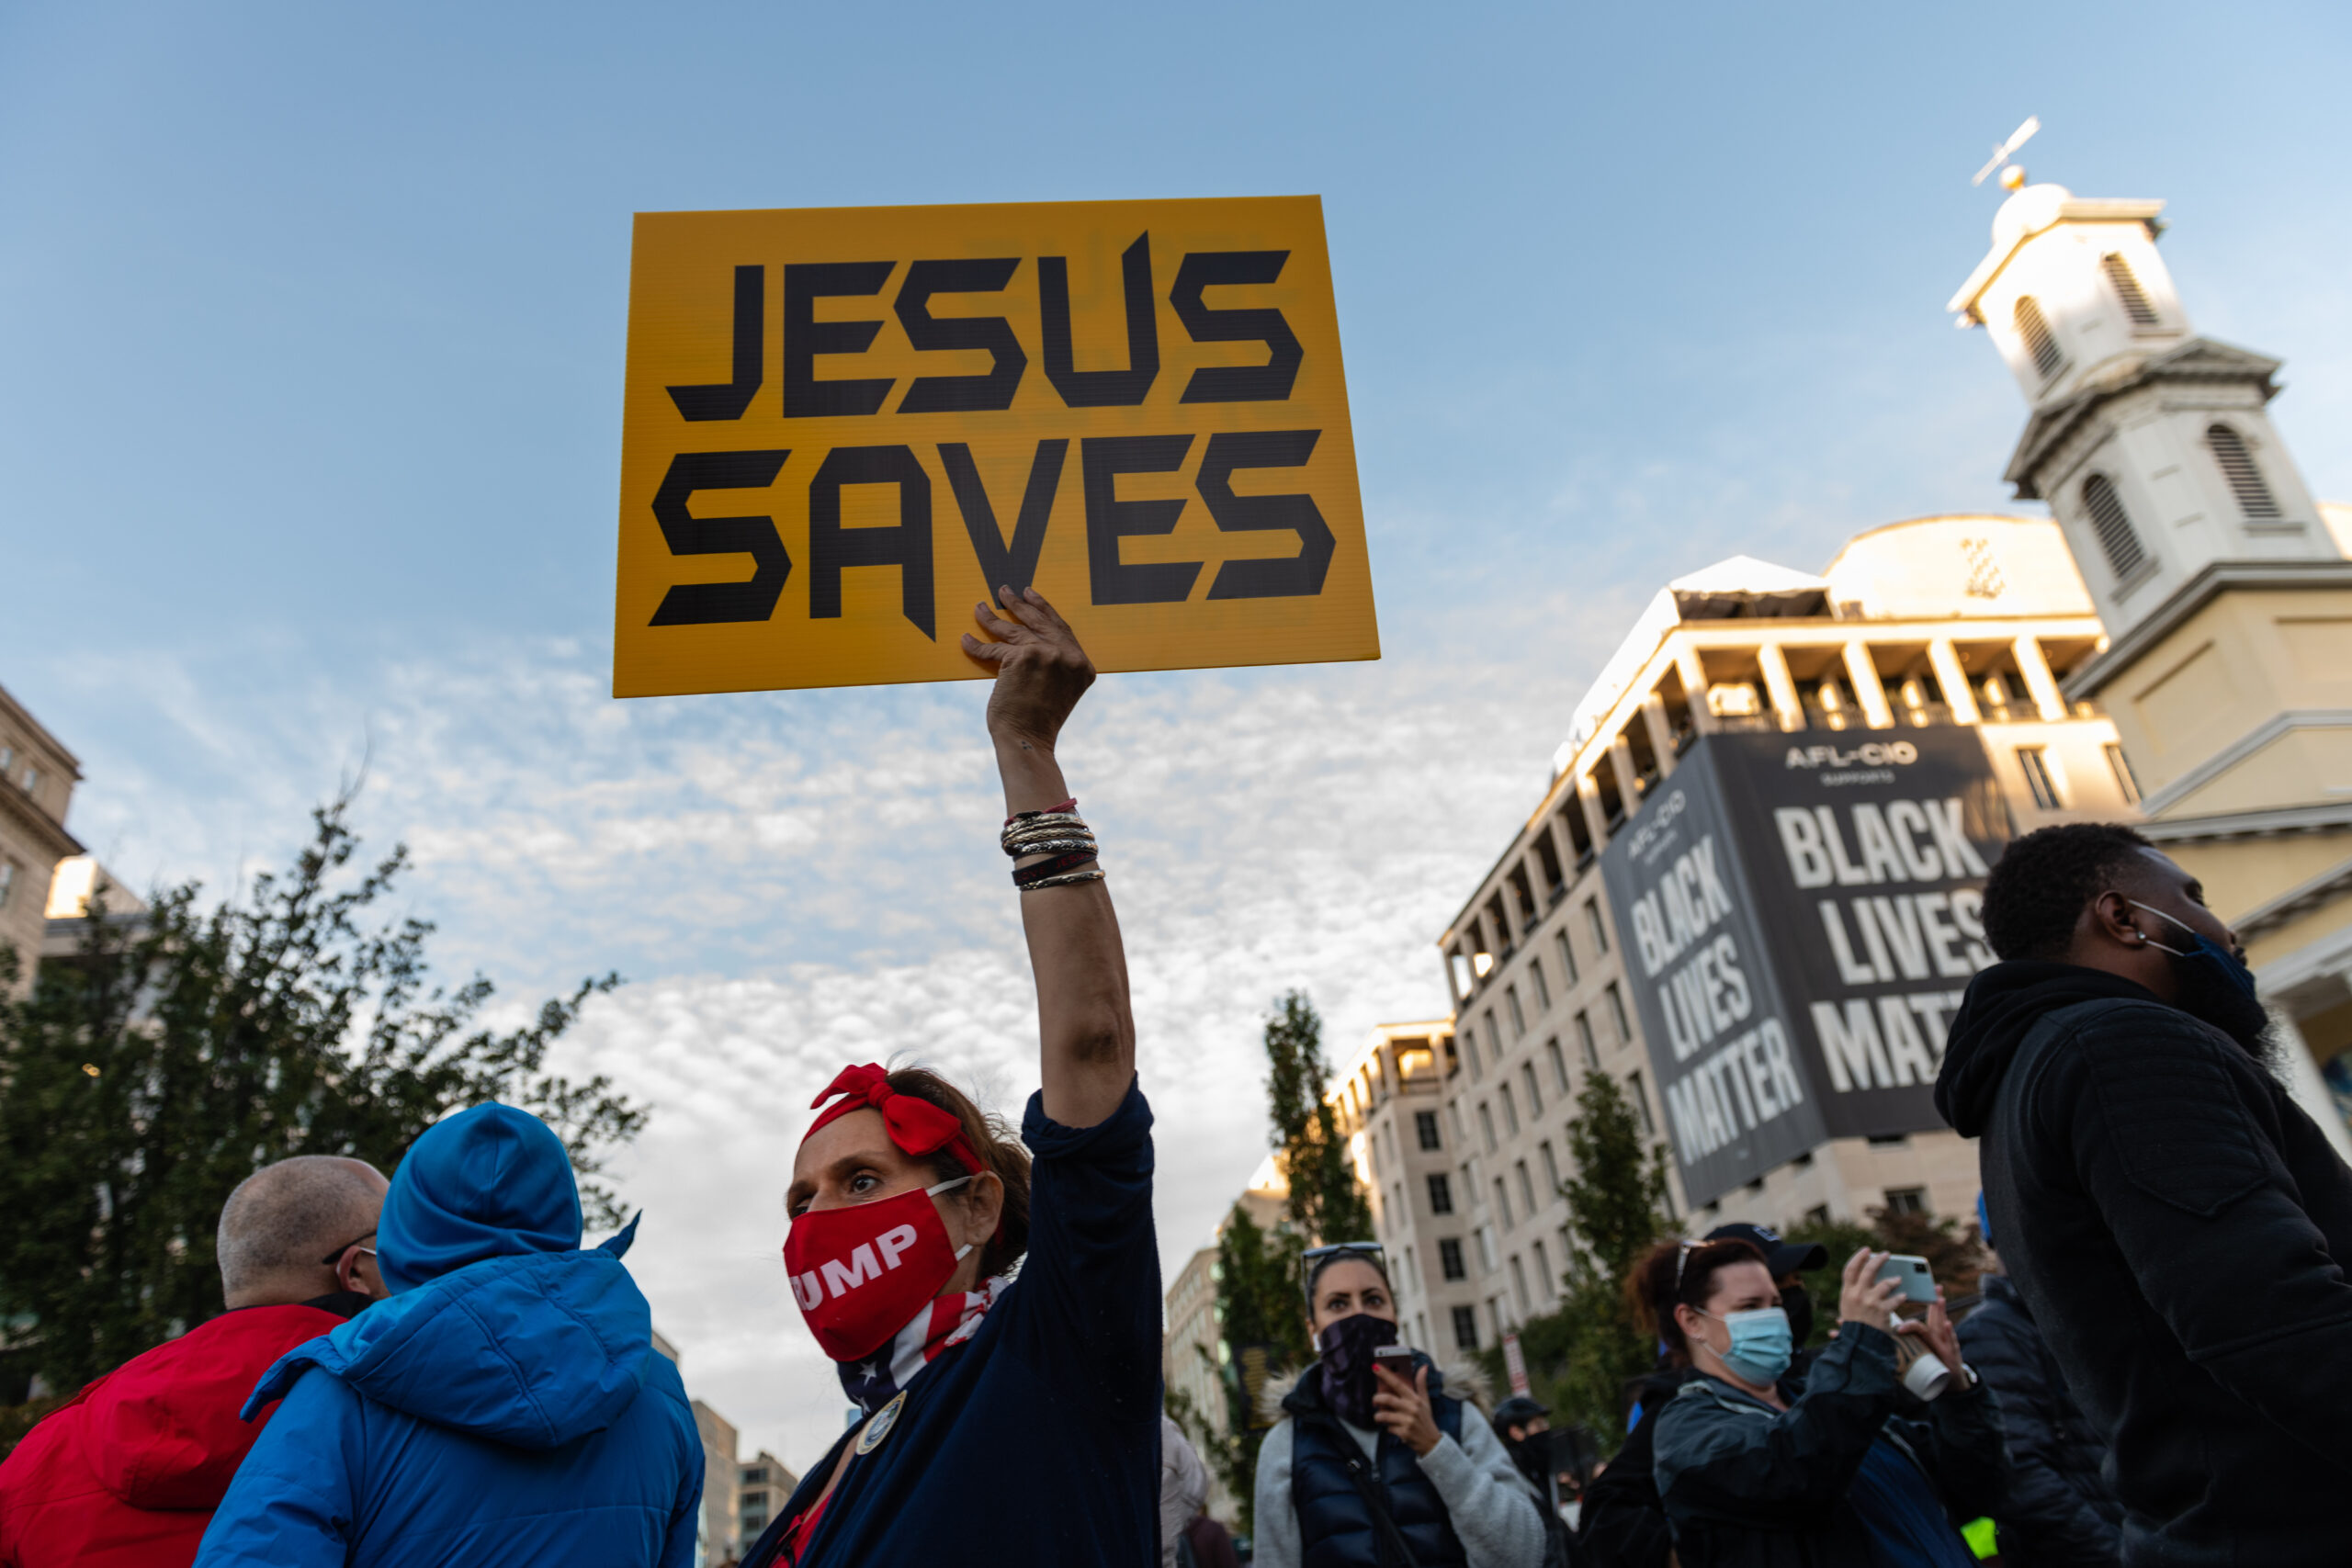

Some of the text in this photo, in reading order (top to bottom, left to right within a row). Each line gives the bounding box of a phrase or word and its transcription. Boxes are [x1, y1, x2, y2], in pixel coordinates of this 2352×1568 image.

[665, 229, 1305, 422] JESUS
[648, 429, 1337, 643] SAVES
[1786, 740, 1918, 769] AFL-CIO
[1630, 834, 1733, 977] BLACK
[1773, 796, 1992, 888] BLACK
[1657, 932, 1752, 1063] LIVES
[1817, 887, 2001, 985] LIVES
[1666, 1017, 1804, 1167] MATTER
